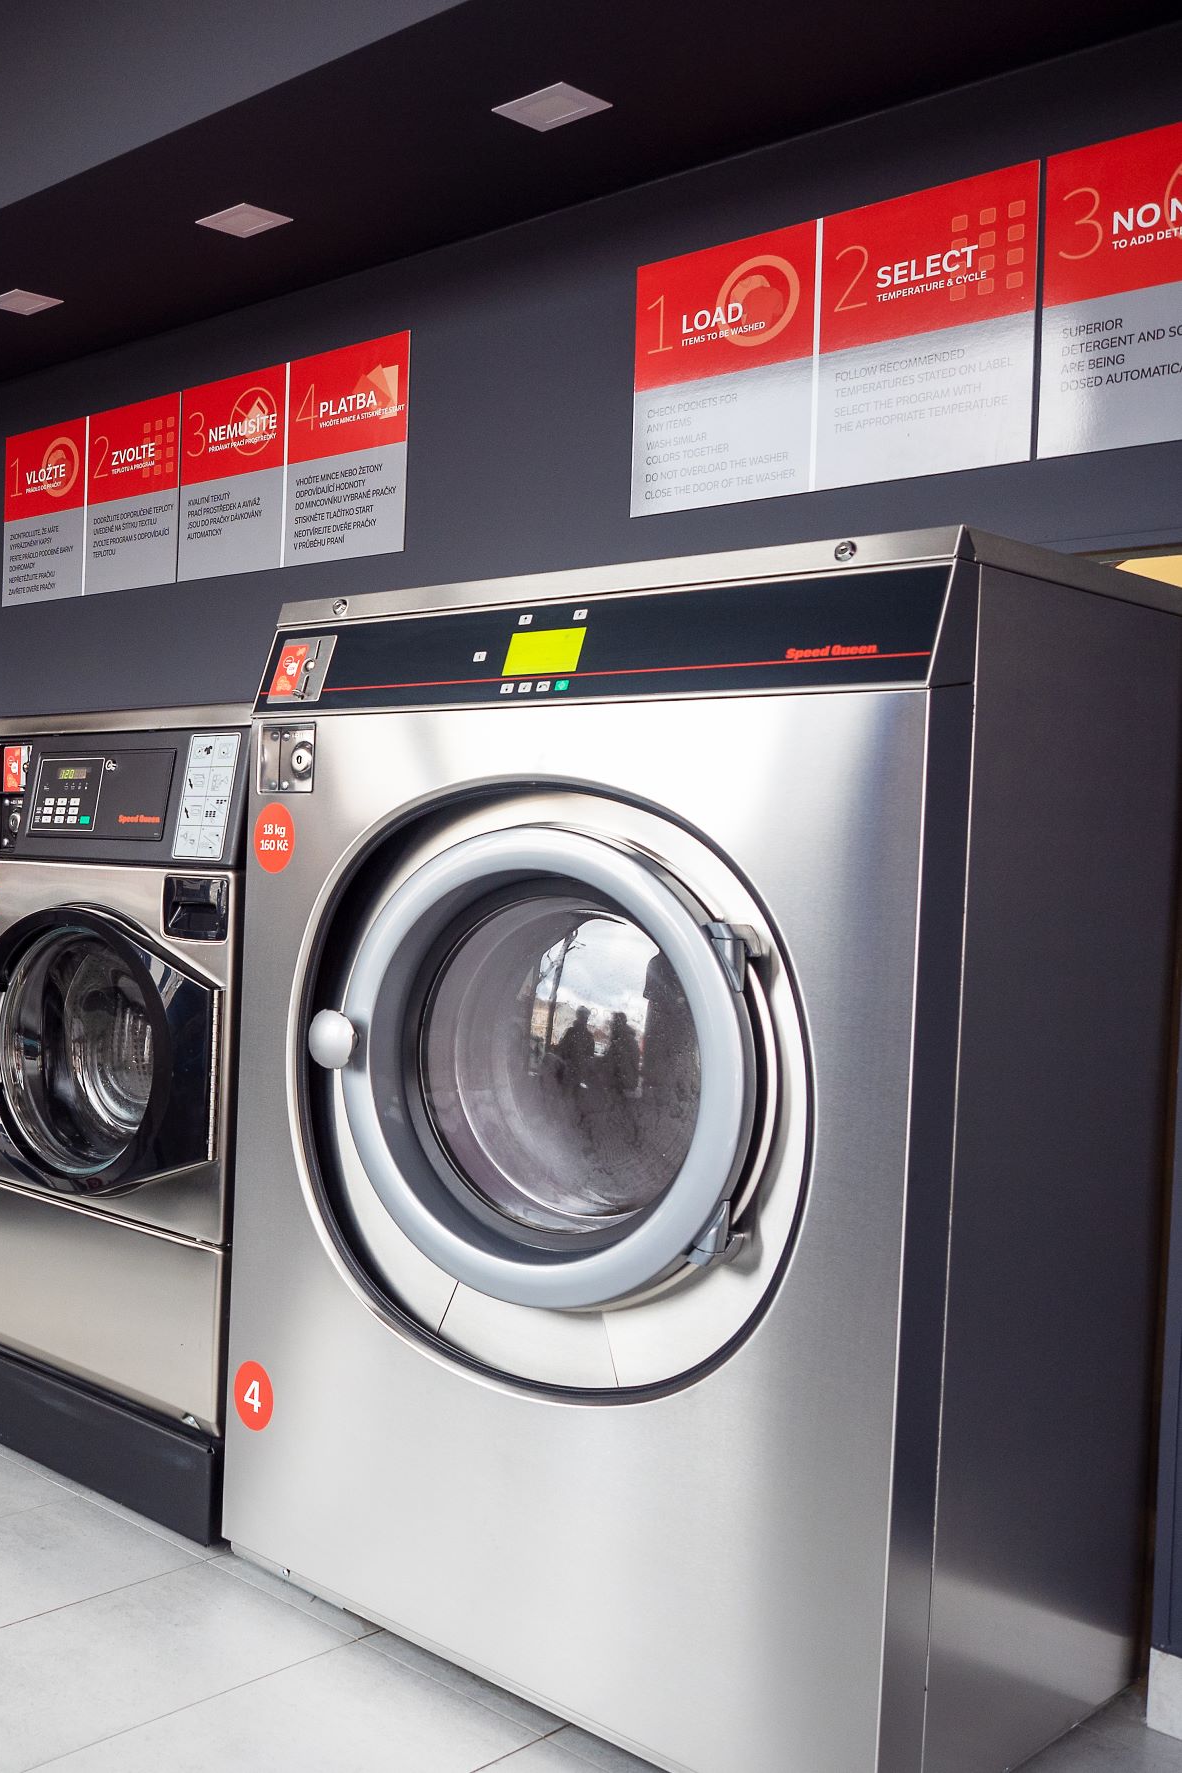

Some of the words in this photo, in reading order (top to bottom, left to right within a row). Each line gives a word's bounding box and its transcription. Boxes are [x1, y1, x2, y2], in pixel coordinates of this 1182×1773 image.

[1058, 187, 1103, 260] 3
[1112, 202, 1161, 235] NO
[1112, 239, 1127, 250] TO
[1130, 233, 1154, 247] ADD
[833, 245, 869, 313] 2
[876, 244, 979, 289] SELECT
[876, 279, 945, 303] TEMPERATURE
[947, 278, 953, 287] &
[955, 270, 987, 285] CYCLE
[646, 294, 673, 355] 1
[682, 302, 744, 334] LOAD
[1062, 318, 1123, 339] SUPERIOR
[681, 335, 706, 347] ITEMS
[707, 333, 718, 342] TO
[719, 330, 730, 338] BE
[730, 321, 766, 336] WASHED
[1062, 334, 1135, 357] DETERGENT
[1137, 329, 1166, 343] AND
[835, 364, 877, 383] FOLLOW
[879, 348, 965, 374] RECOMMENDED
[835, 374, 915, 398] TEMPERATURES
[917, 366, 957, 383] STATED
[958, 362, 976, 375] ON
[978, 356, 1014, 370] LABEL
[1061, 361, 1085, 375] ARE
[1088, 354, 1125, 370] BEING
[1060, 376, 1103, 392] DOSED
[296, 383, 318, 431] 4
[320, 390, 377, 418] PLATBA
[388, 404, 405, 413] START
[647, 404, 676, 419] CHECK
[678, 396, 718, 413] POCKETS
[720, 393, 738, 404] FOR
[834, 401, 870, 418] SELECT
[874, 398, 894, 411] THE
[896, 388, 950, 407] PROGRAM
[953, 382, 982, 397] WITH
[646, 423, 664, 434] ANY
[666, 417, 692, 430] ITEMS
[834, 422, 853, 434] THE
[855, 409, 925, 431] APPROPRIATE
[928, 394, 1008, 418] TEMPERATURE
[187, 412, 205, 457] 3
[209, 414, 277, 443] NEMUSÍTE
[646, 439, 672, 451] WASH
[673, 432, 707, 446] SIMILAR
[94, 436, 109, 478] 2
[112, 442, 155, 466] ZVOLTE
[645, 451, 681, 466] COLORS
[682, 443, 730, 459] TOGETHER
[645, 472, 658, 483] DO
[660, 469, 678, 480] NOT
[680, 461, 727, 477] OVERLOAD
[730, 458, 747, 469] THE
[749, 451, 789, 466] WASHER
[10, 458, 22, 497] 1
[26, 464, 66, 485] VLOŽTE
[296, 475, 319, 486] VHOĎTE
[320, 472, 339, 481] MINCE
[340, 468, 357, 478] NEBO
[358, 463, 383, 475] ŽETONY
[336, 479, 366, 491] HODNOTY
[644, 487, 672, 500] CLOSE
[674, 484, 691, 495] THE
[693, 480, 719, 493] DOOR
[721, 478, 735, 488] OF
[737, 475, 753, 486] THE
[755, 468, 796, 483] WASHER
[295, 502, 304, 510] DO
[343, 489, 371, 501] VYBRANÉ
[372, 486, 396, 497] PRAČKY
[326, 508, 354, 519] TLAČÍTKO
[355, 505, 373, 514] START
[333, 522, 352, 533] DVEŘE
[353, 518, 376, 529] PRAČKY
[327, 534, 345, 546] PRANÍ
[785, 645, 830, 661] Speed
[831, 645, 878, 656] Queen
[263, 824, 274, 835] 18
[275, 824, 286, 838] kg
[260, 839, 275, 851] 160
[276, 839, 289, 852] Kč
[244, 1380, 261, 1413] 4
